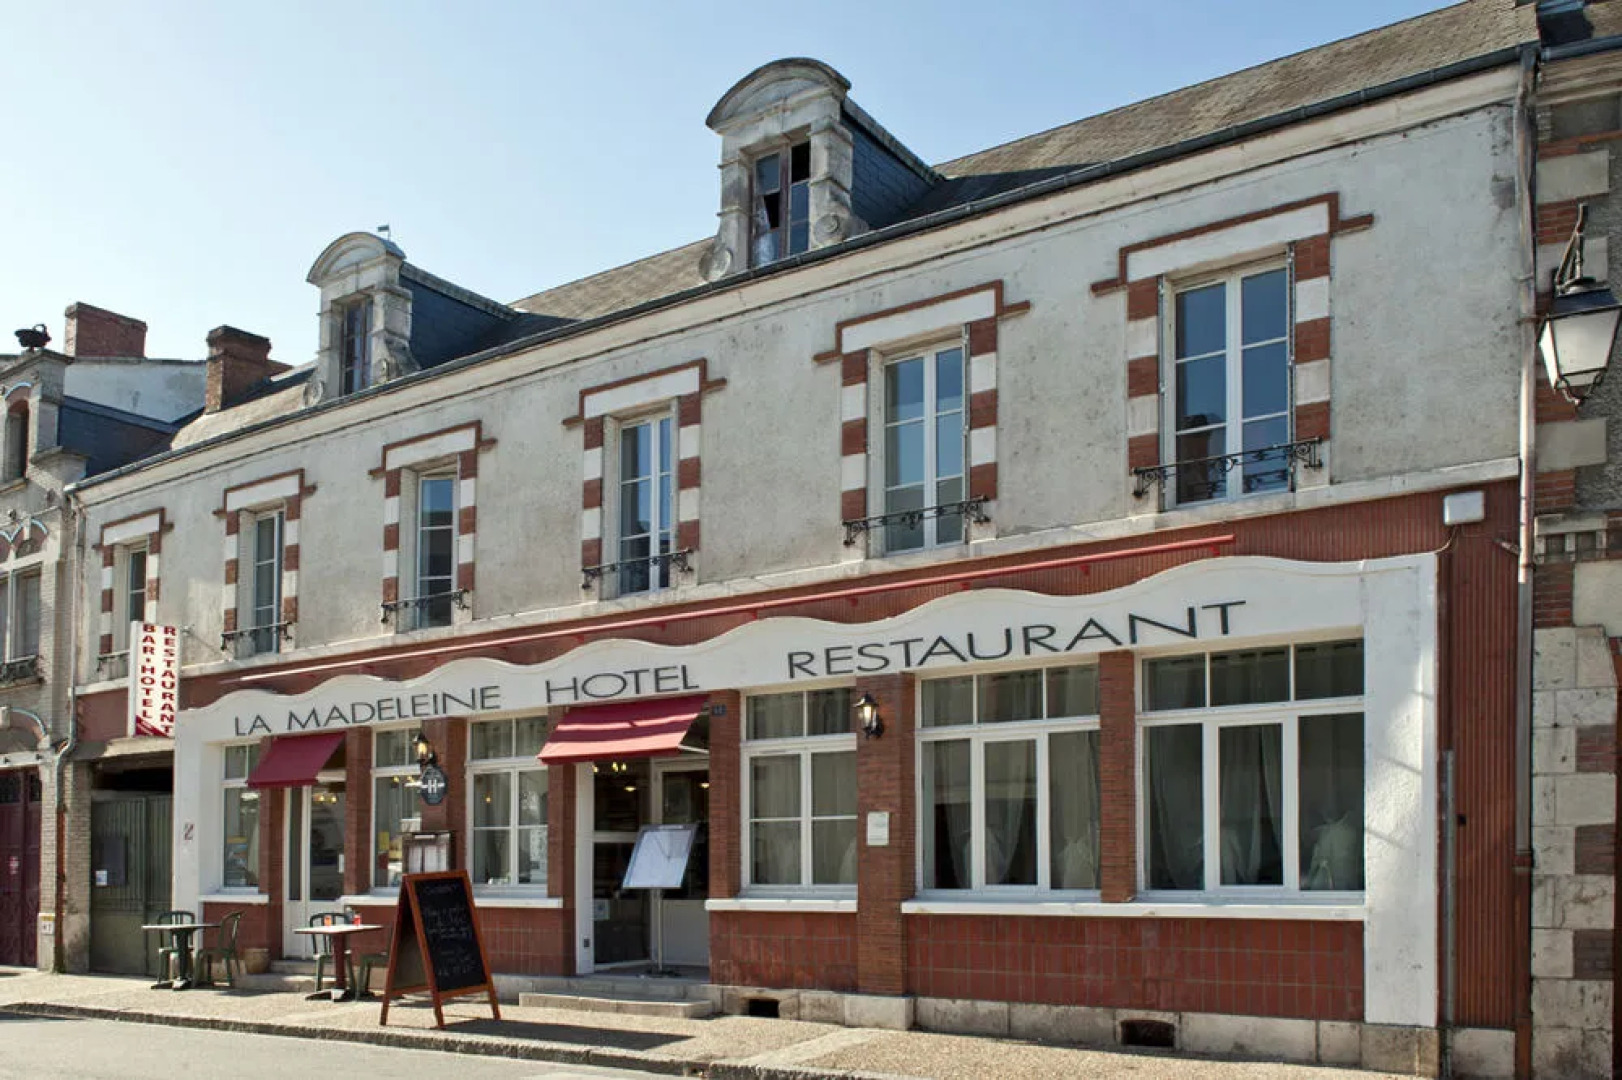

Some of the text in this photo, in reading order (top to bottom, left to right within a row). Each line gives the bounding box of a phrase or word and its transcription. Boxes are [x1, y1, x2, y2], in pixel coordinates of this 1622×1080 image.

[160, 625, 176, 734] RESTAURANT
[234, 600, 1247, 737] LA MADELEINE HOTEL RESTAURANT
